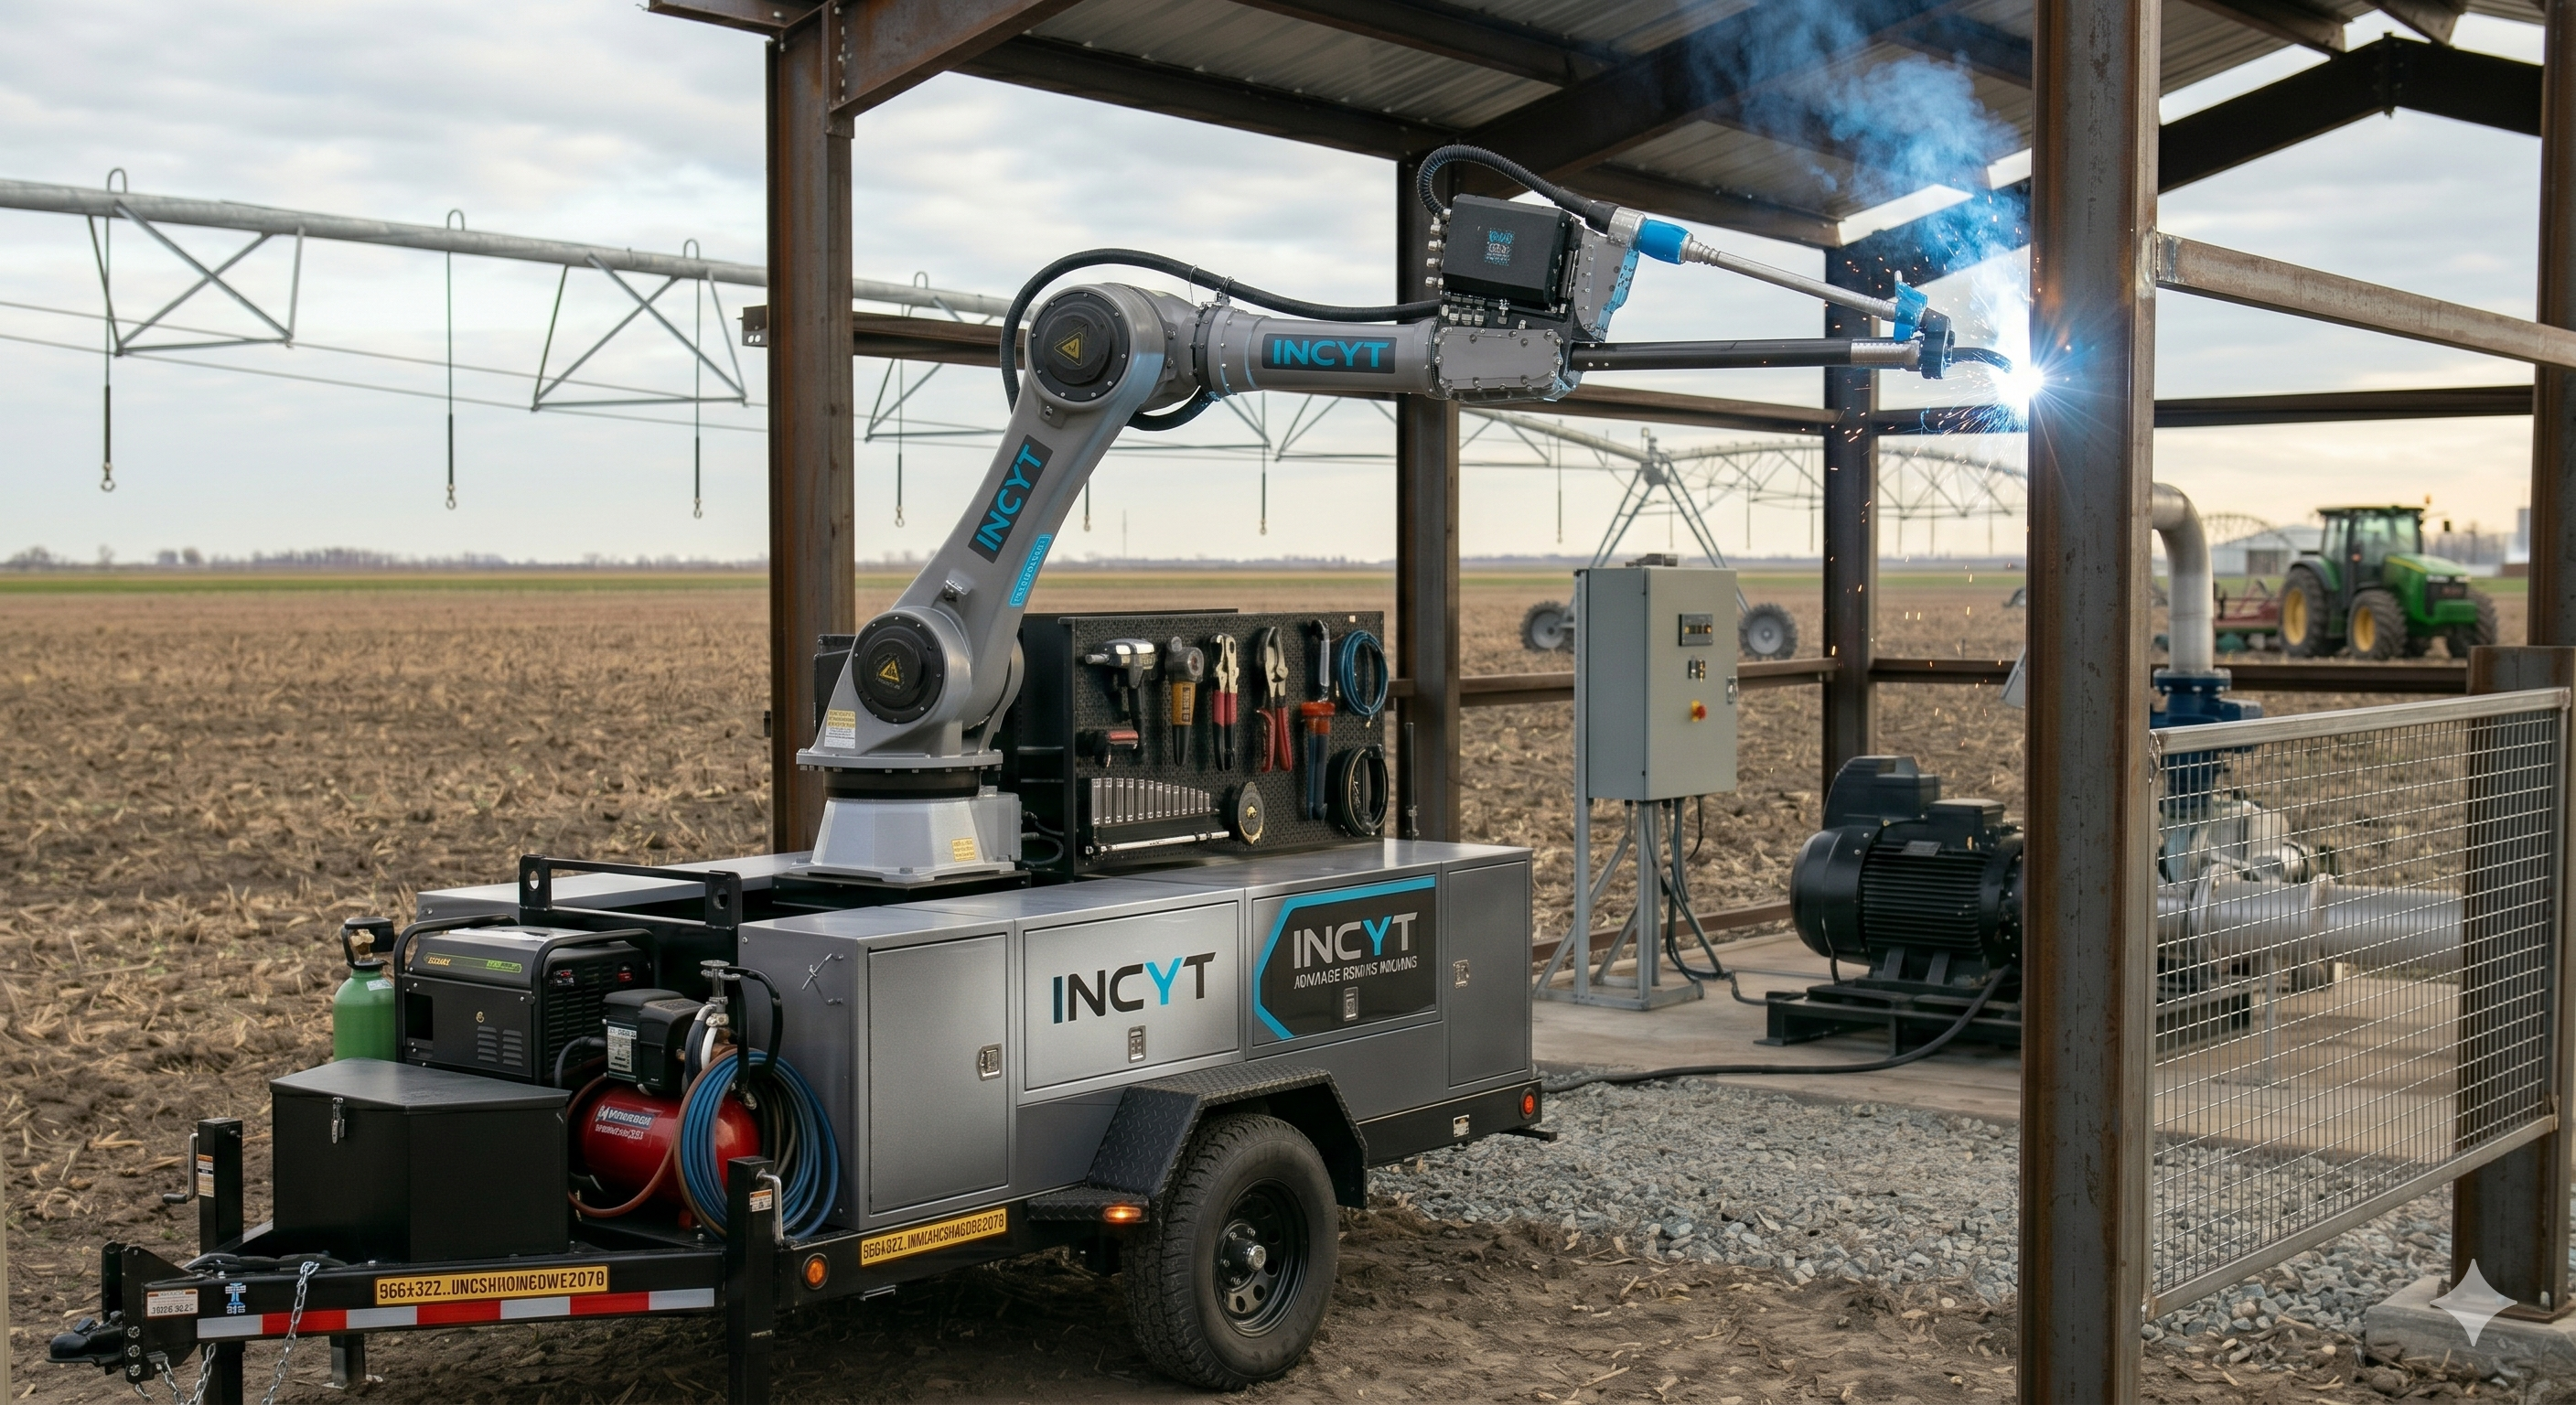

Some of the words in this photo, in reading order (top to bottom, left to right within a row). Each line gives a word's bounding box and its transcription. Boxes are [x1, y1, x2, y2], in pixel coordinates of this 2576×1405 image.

[1273, 339, 1390, 368] INCYT
[976, 444, 1042, 552] INCYT
[1293, 912, 1418, 970] INCYT
[1054, 952, 1217, 1024] INCYT
